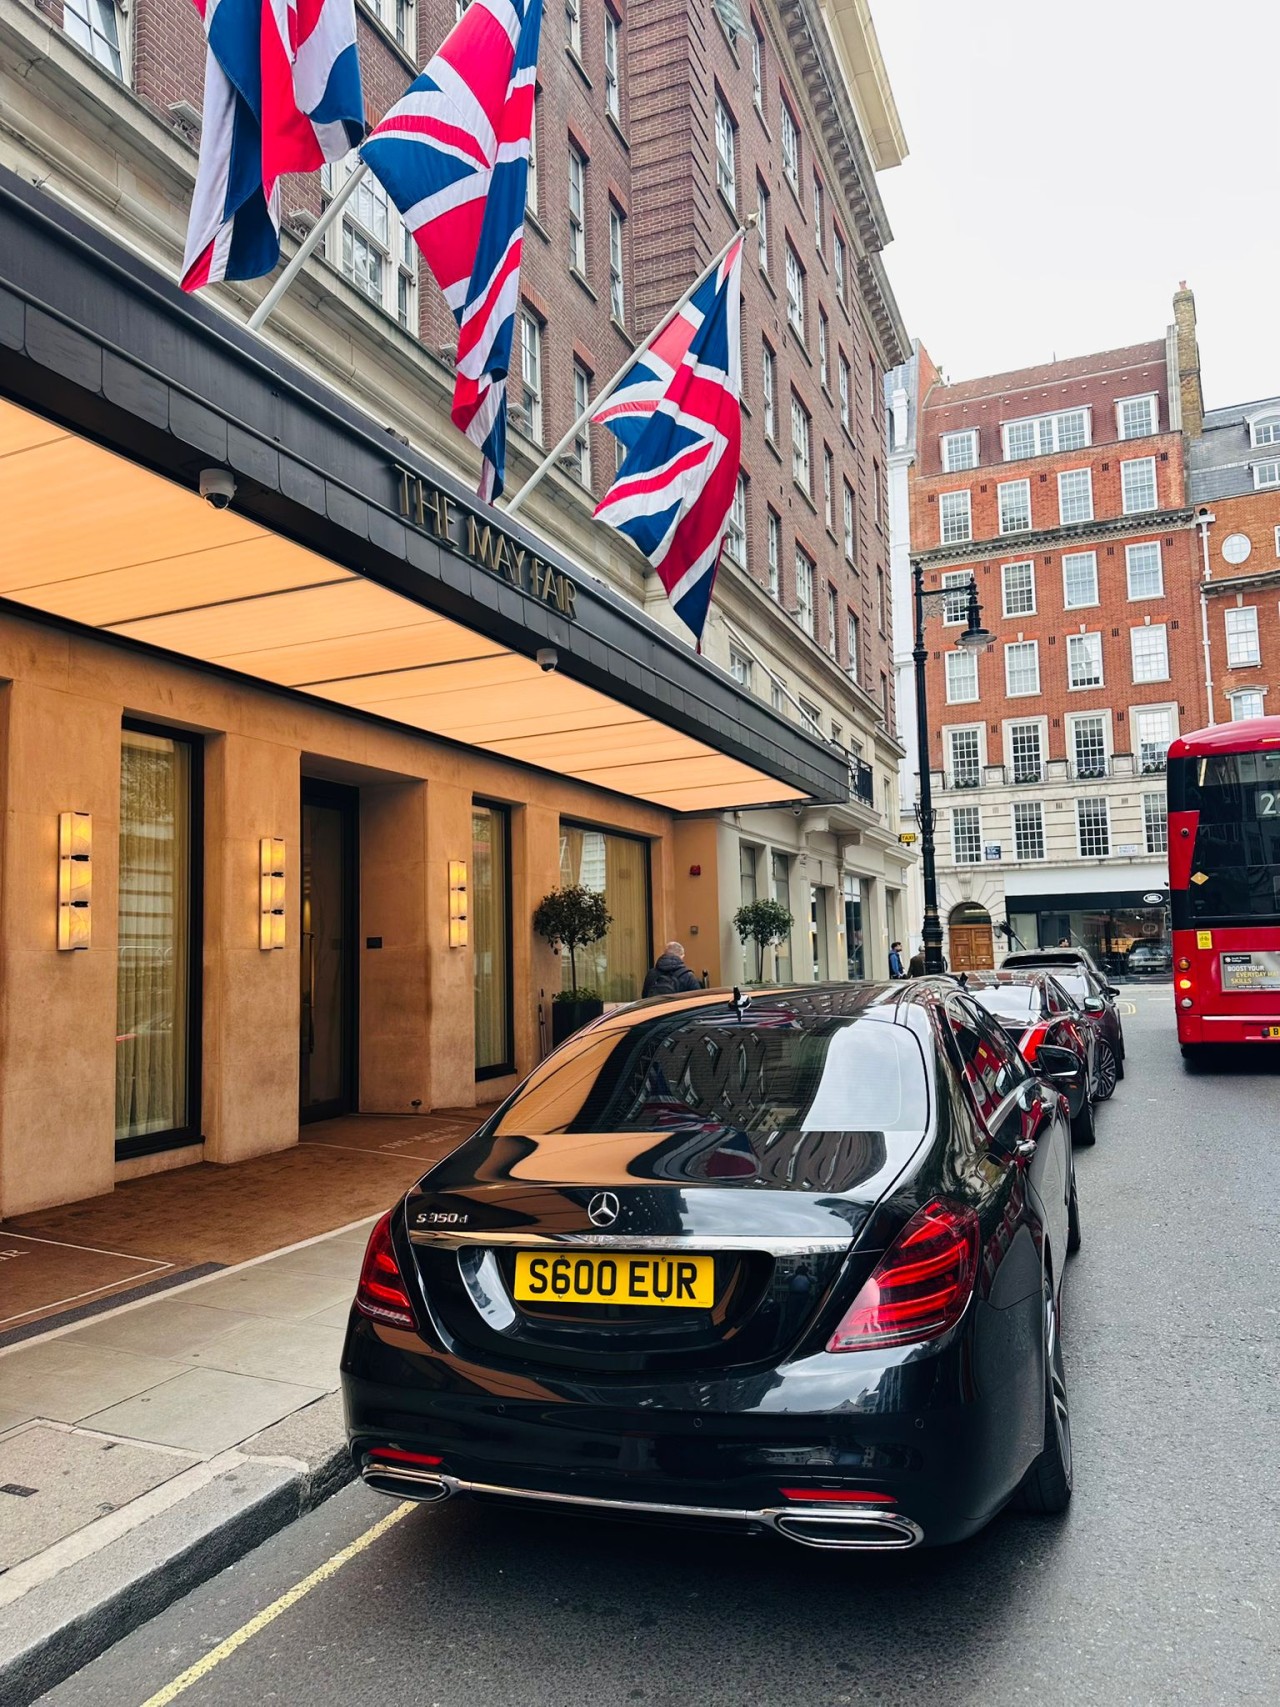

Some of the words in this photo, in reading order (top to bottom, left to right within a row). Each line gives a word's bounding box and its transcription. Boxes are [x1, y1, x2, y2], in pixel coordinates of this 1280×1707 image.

[394, 463, 459, 547] THE
[1261, 793, 1280, 815] 2
[528, 1258, 617, 1297] S600
[628, 1260, 698, 1300] EUR
